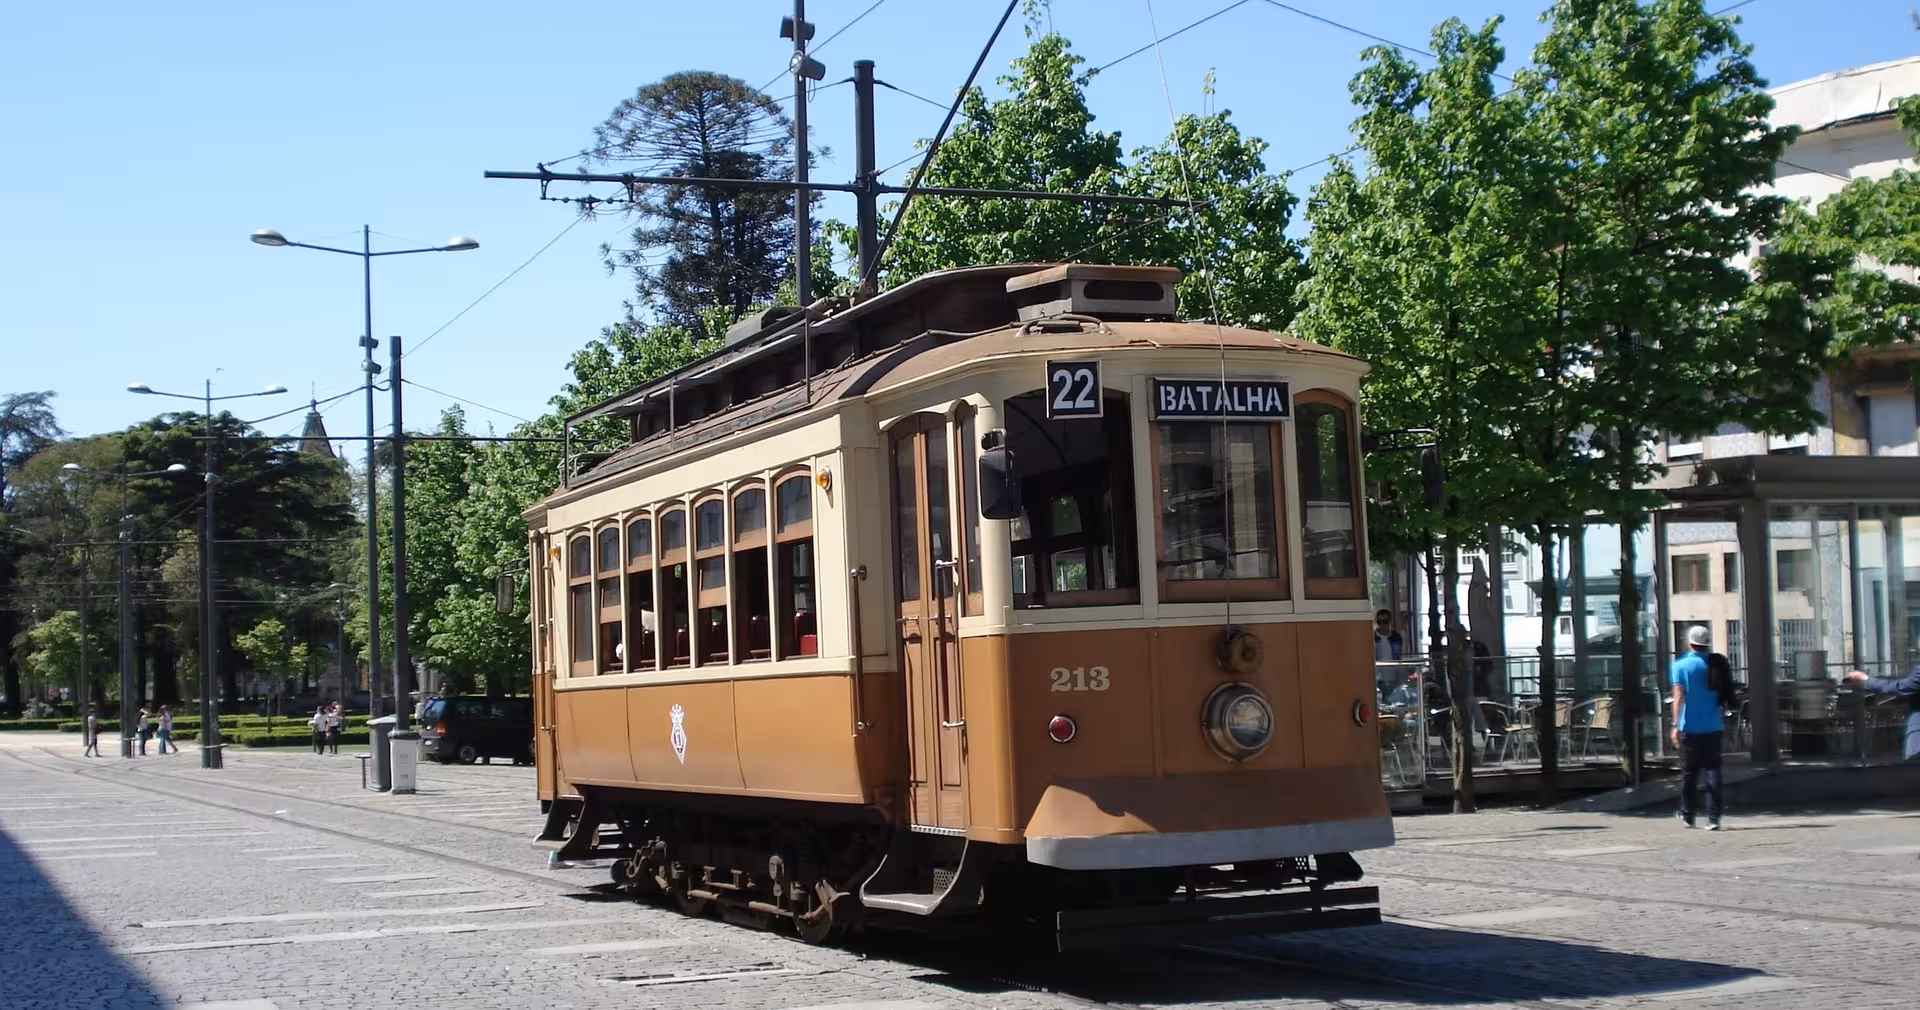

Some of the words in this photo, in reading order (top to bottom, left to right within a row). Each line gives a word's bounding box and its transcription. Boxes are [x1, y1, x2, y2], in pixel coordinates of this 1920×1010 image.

[1053, 369, 1095, 409] 22
[1160, 386, 1283, 411] BATALHA
[1050, 666, 1110, 692] 213
